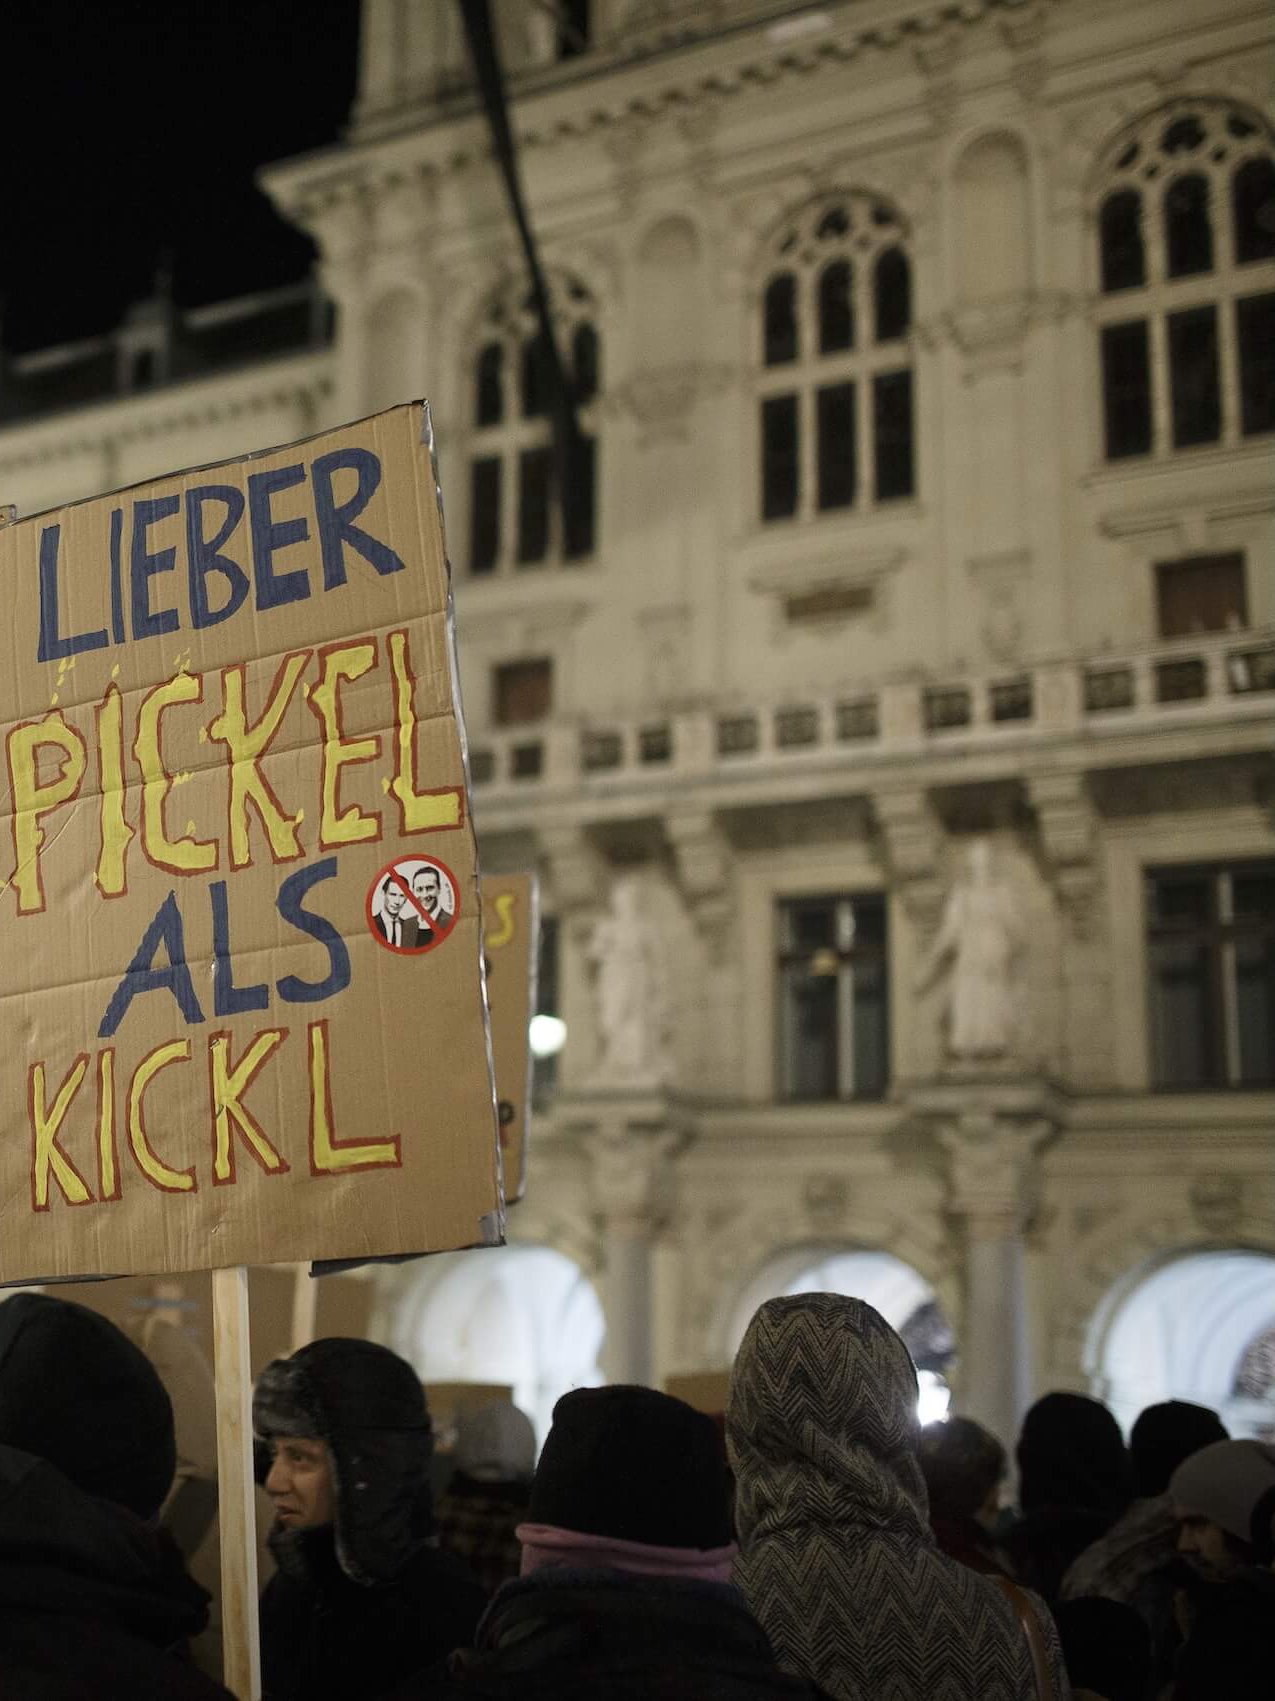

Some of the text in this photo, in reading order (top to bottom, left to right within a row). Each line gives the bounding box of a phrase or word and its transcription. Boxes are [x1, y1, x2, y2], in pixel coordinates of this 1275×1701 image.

[37, 447, 406, 663] LIEBER
[5, 628, 465, 917] PICKEL
[97, 856, 352, 1038] ALS
[28, 1018, 403, 1213] KICKL
